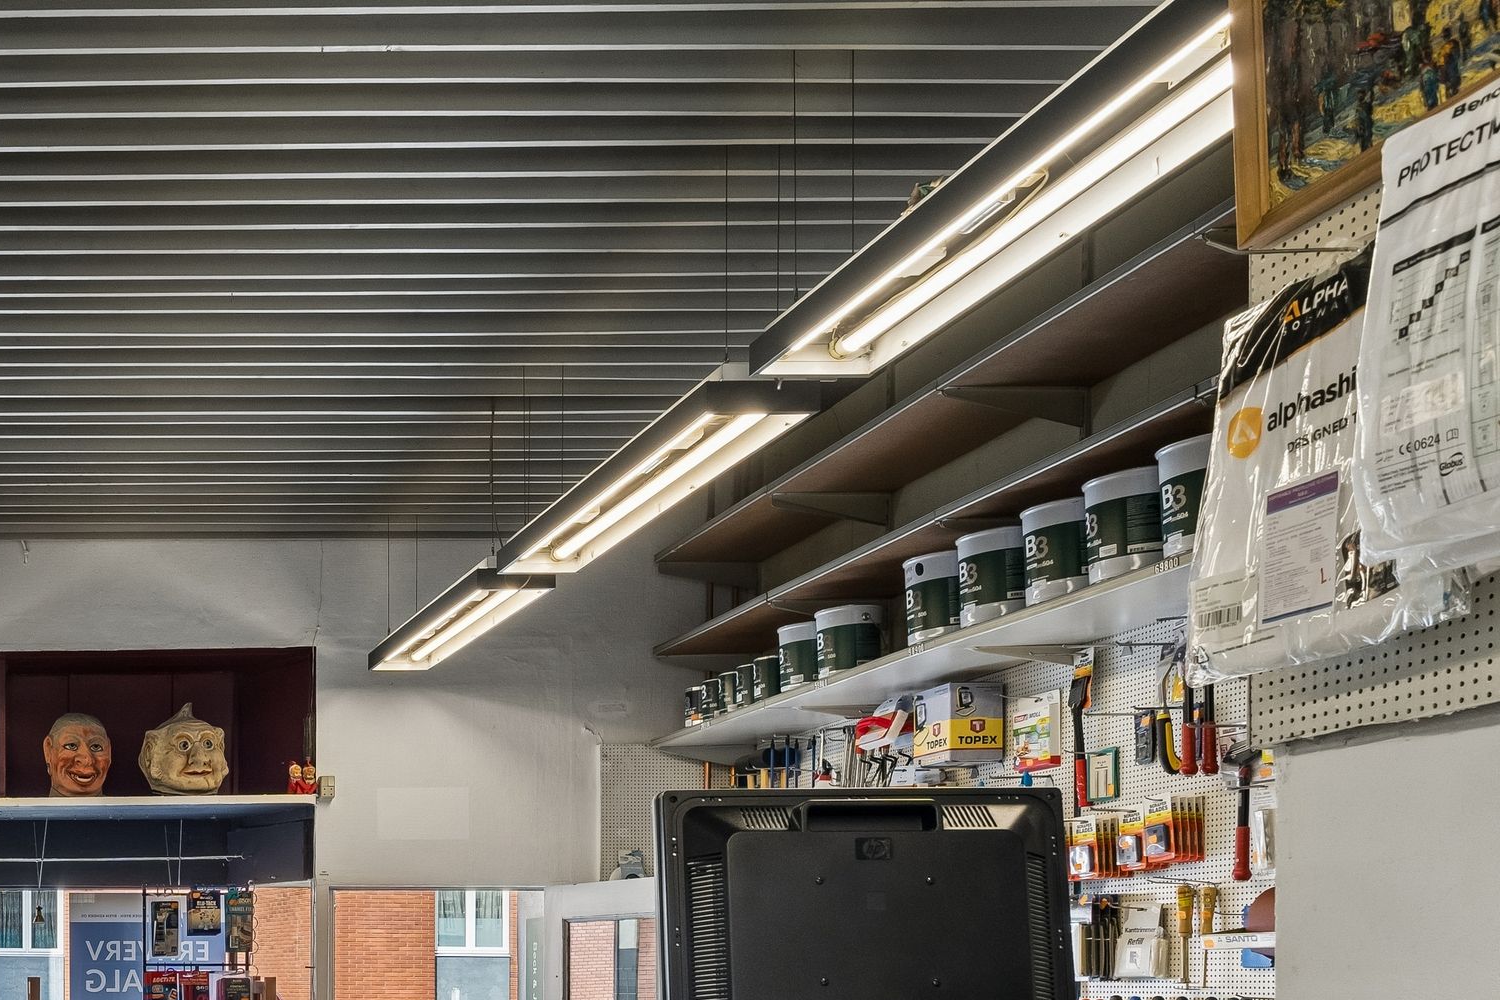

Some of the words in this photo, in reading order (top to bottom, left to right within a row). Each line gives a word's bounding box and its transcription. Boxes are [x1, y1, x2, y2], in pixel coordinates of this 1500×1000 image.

[1283, 276, 1349, 326] ALPHA
[1414, 433, 1441, 452] 0624
[1438, 457, 1465, 472] Globus
[1161, 483, 1187, 511] B3
[1025, 535, 1049, 559] B3
[959, 562, 978, 584] B3
[1154, 556, 1180, 574] 69800
[906, 589, 922, 609] B3
[926, 738, 948, 750] TOPEX
[957, 734, 998, 745] TOPEX
[1149, 805, 1168, 814] BLADES
[1122, 816, 1141, 824] BLADES
[1127, 937, 1144, 946] Refill
[1225, 935, 1258, 943] SANTO
